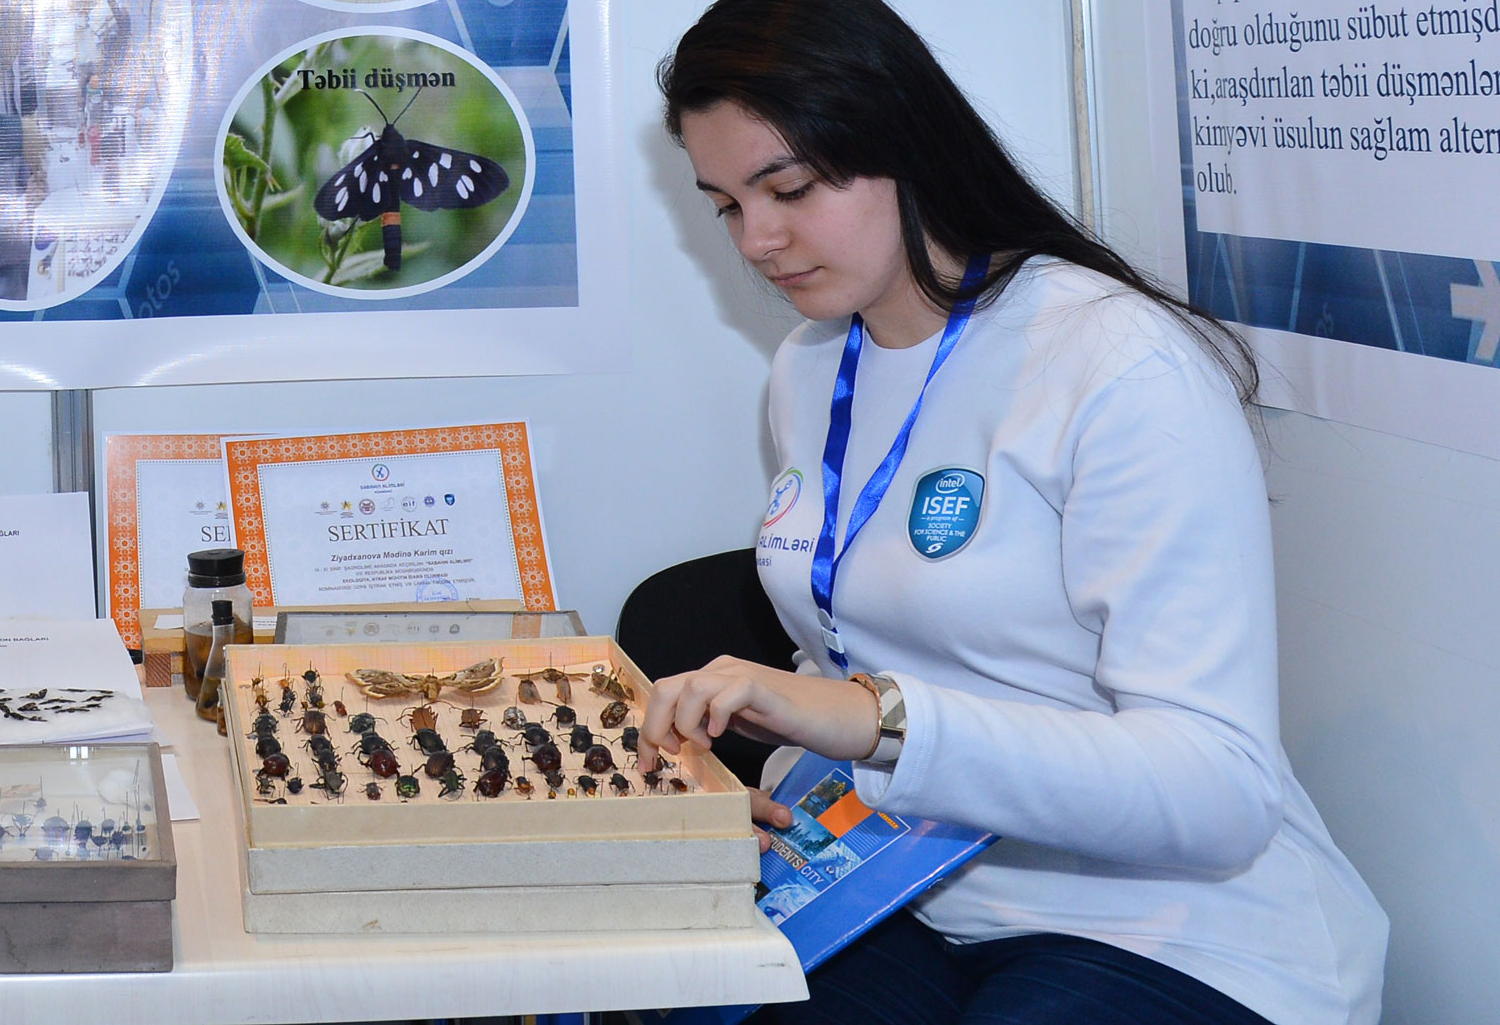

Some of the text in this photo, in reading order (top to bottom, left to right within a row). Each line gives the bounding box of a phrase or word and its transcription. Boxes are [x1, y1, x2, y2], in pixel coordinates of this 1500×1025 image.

[1189, 4, 1409, 56] doğru olduğunu sübut
[297, 68, 455, 92] Təbii düşmən
[1320, 63, 1369, 98] təbii
[1194, 116, 1432, 161] kimyəvi üsulun sağlam
[1197, 162, 1236, 194] olub.
[940, 478, 960, 488] intel
[922, 496, 971, 516] ISEF
[328, 518, 449, 542] SERTİFİKAT
[331, 549, 453, 563] Ziyadxanova Mədinə Kərim qızı
[800, 865, 824, 885] CITY
